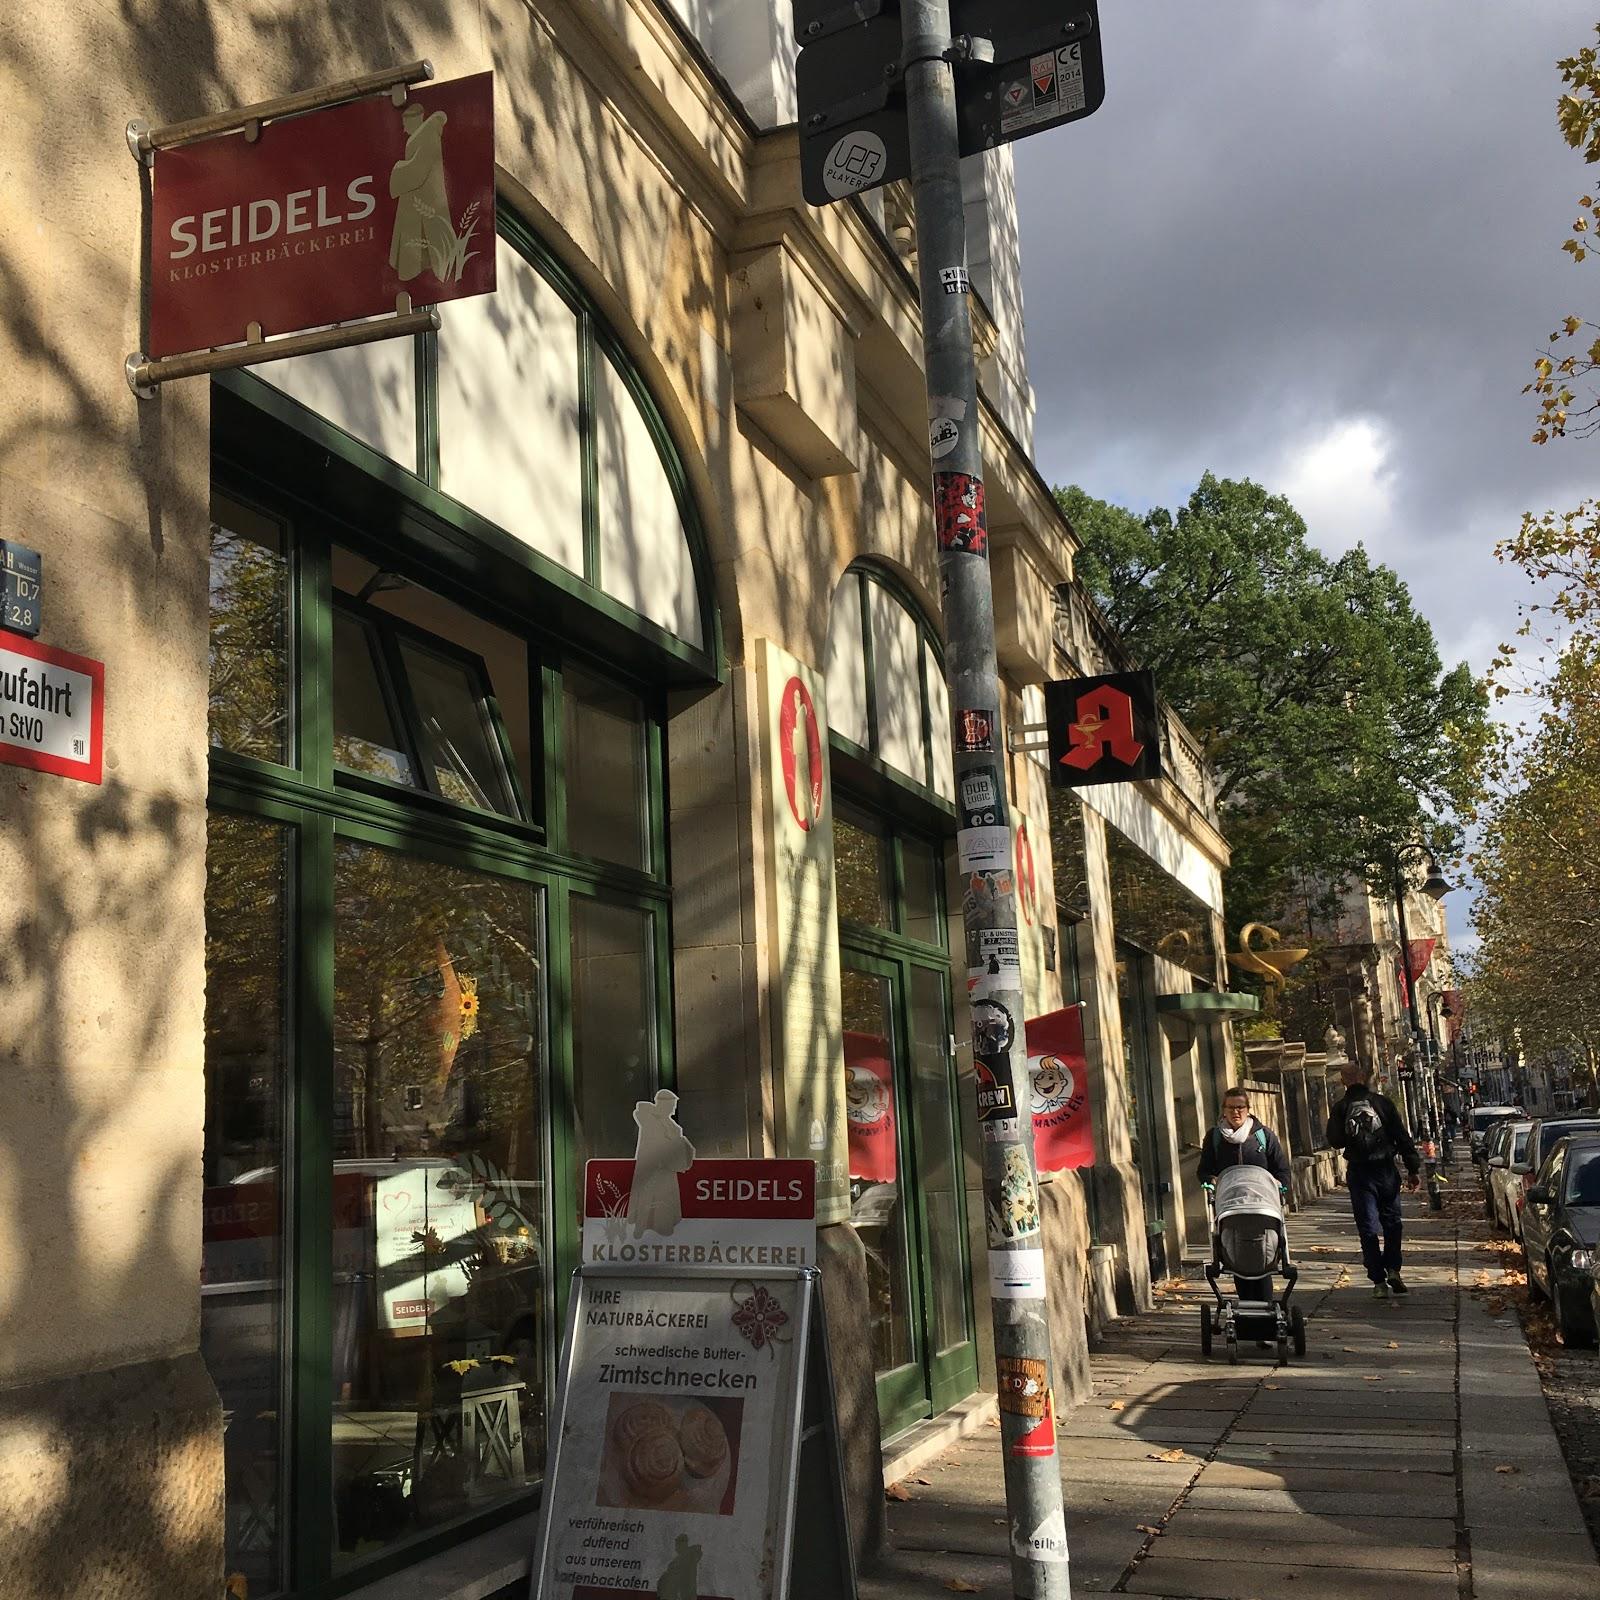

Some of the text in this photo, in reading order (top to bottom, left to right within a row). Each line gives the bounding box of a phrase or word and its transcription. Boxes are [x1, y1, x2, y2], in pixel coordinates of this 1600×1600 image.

[1060, 68, 1081, 82] 2014
[169, 175, 376, 260] SEIDELS
[169, 226, 376, 283] KLOSTERBÄCKEREI
[0, 667, 72, 718] ufahrt
[9, 712, 43, 743] StVO
[965, 780, 989, 795] DUB
[695, 1178, 803, 1201] SEIDELS
[591, 1240, 807, 1265] KLOSTERBÄCKEREI
[588, 1290, 621, 1305] IHRE
[395, 1304, 431, 1315] SEIDELS
[586, 1309, 709, 1329] NATURBÄCKEREI
[615, 1344, 746, 1361] schwedische Butter-
[598, 1364, 758, 1389] Zimtschnecken
[568, 1517, 645, 1534] verführerisch
[582, 1535, 630, 1551] duftend
[565, 1555, 642, 1570] aus unserem
